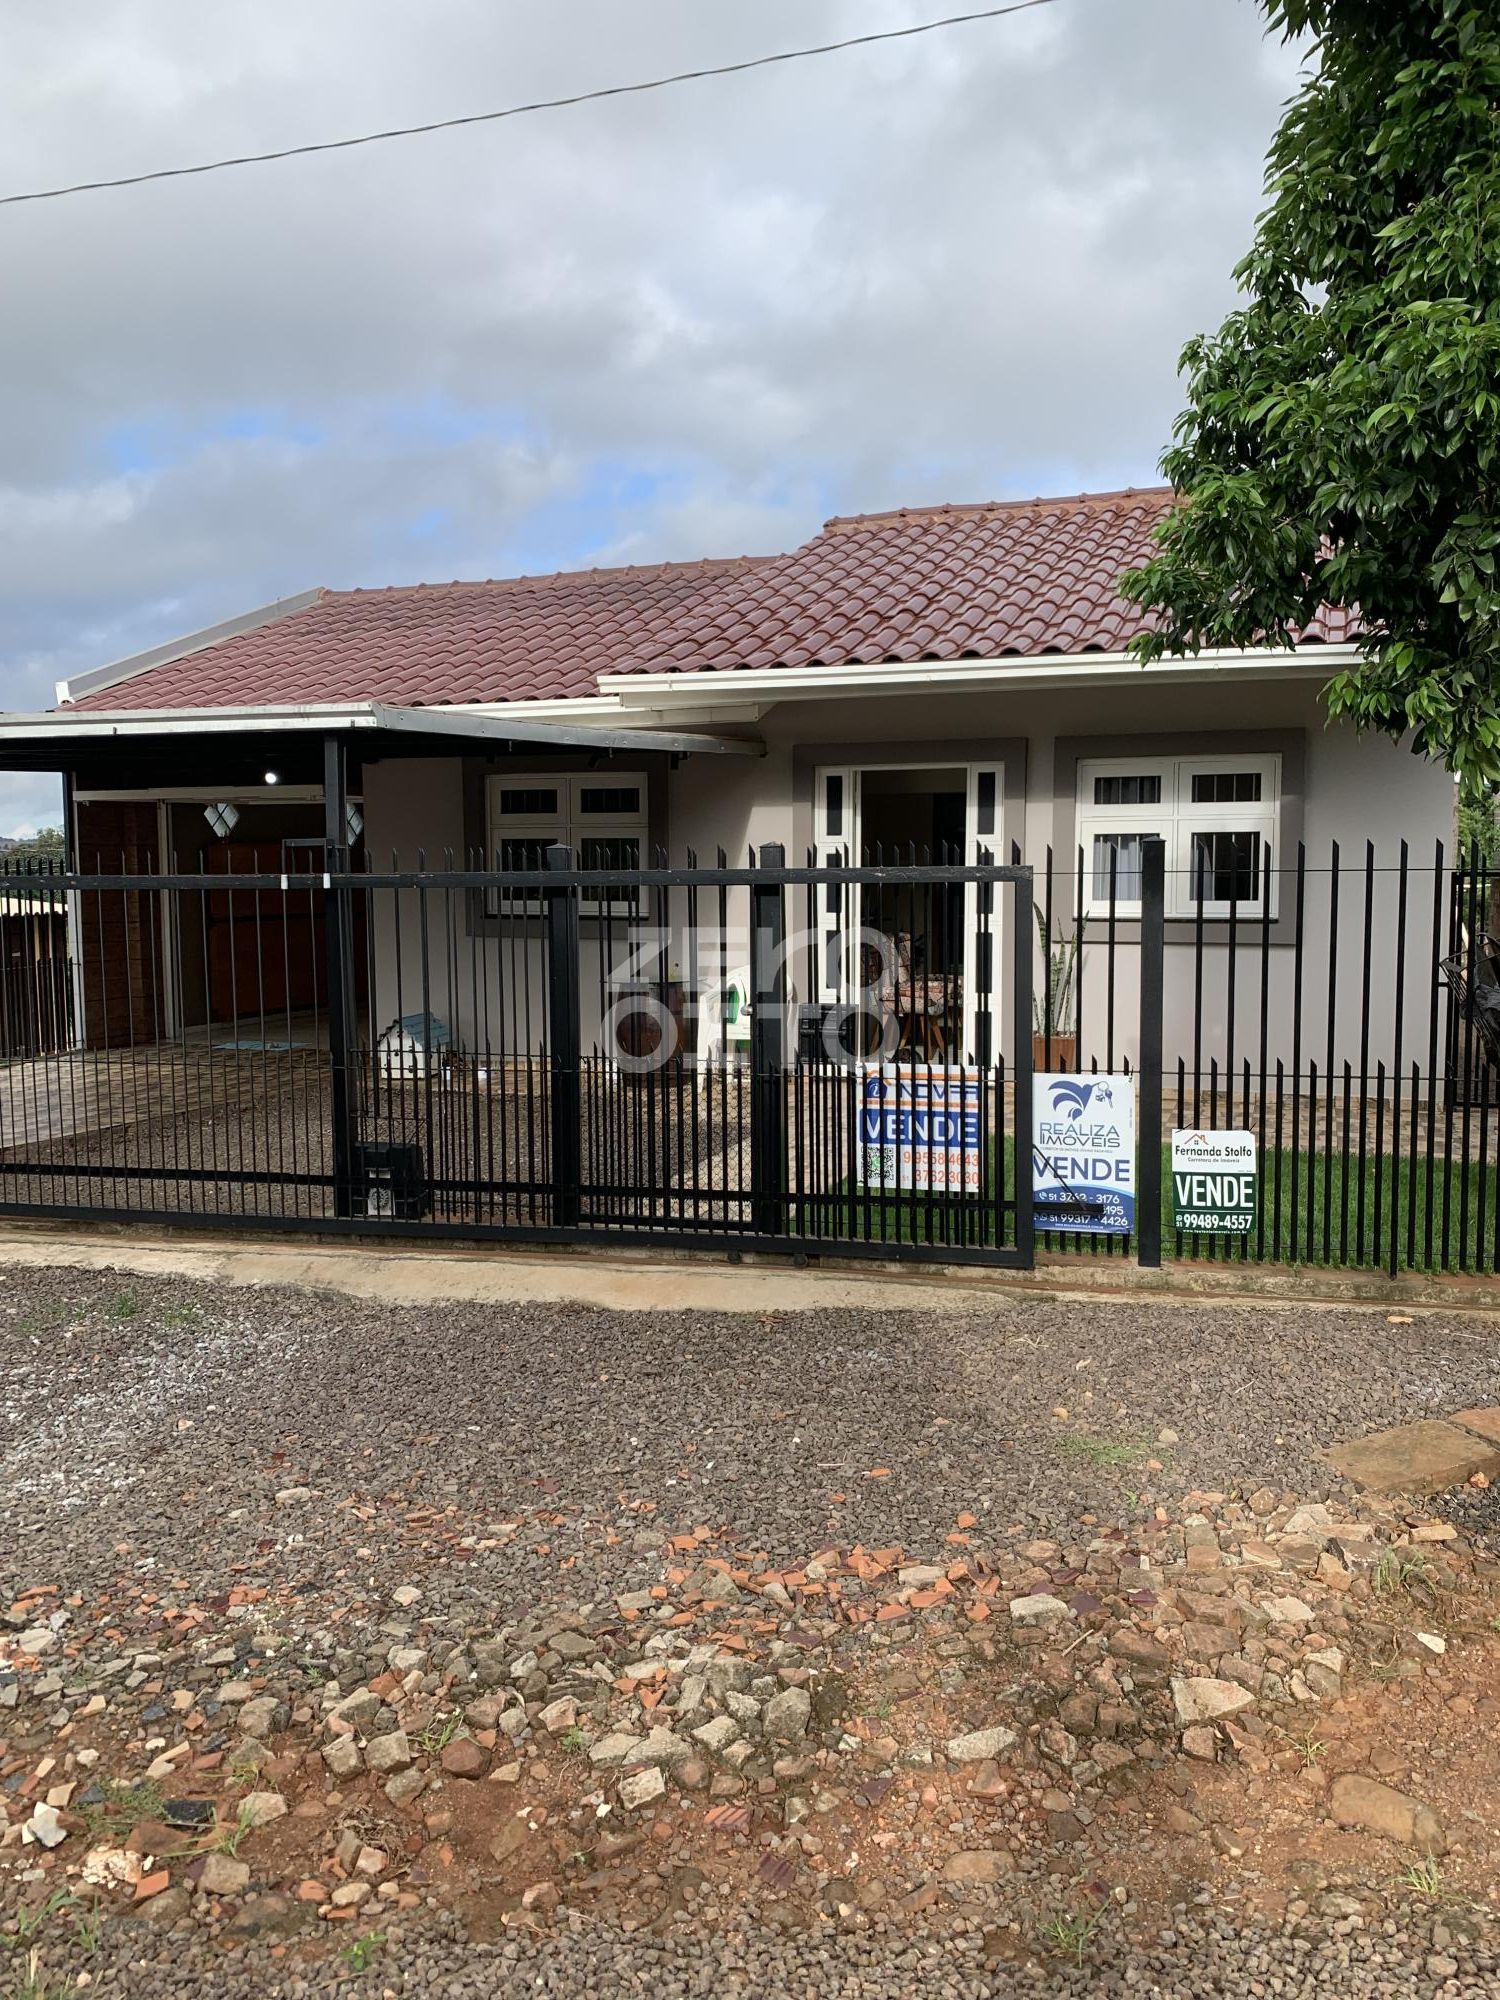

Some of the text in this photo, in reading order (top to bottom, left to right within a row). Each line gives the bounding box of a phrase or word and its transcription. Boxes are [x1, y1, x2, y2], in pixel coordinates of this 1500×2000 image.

[866, 1114, 977, 1142] VENDE
[1039, 1122, 1120, 1137] REALIZA
[1042, 1134, 1120, 1148] IMÓVEIS
[1175, 1145, 1252, 1157] Fernanda Stolfo
[1033, 1156, 1130, 1182] VENDE
[1175, 1174, 1254, 1207] VENDE
[1096, 1194, 1120, 1204] 3176
[1101, 1216, 1128, 1226] 4426
[1183, 1213, 1253, 1229] 99489-4557
